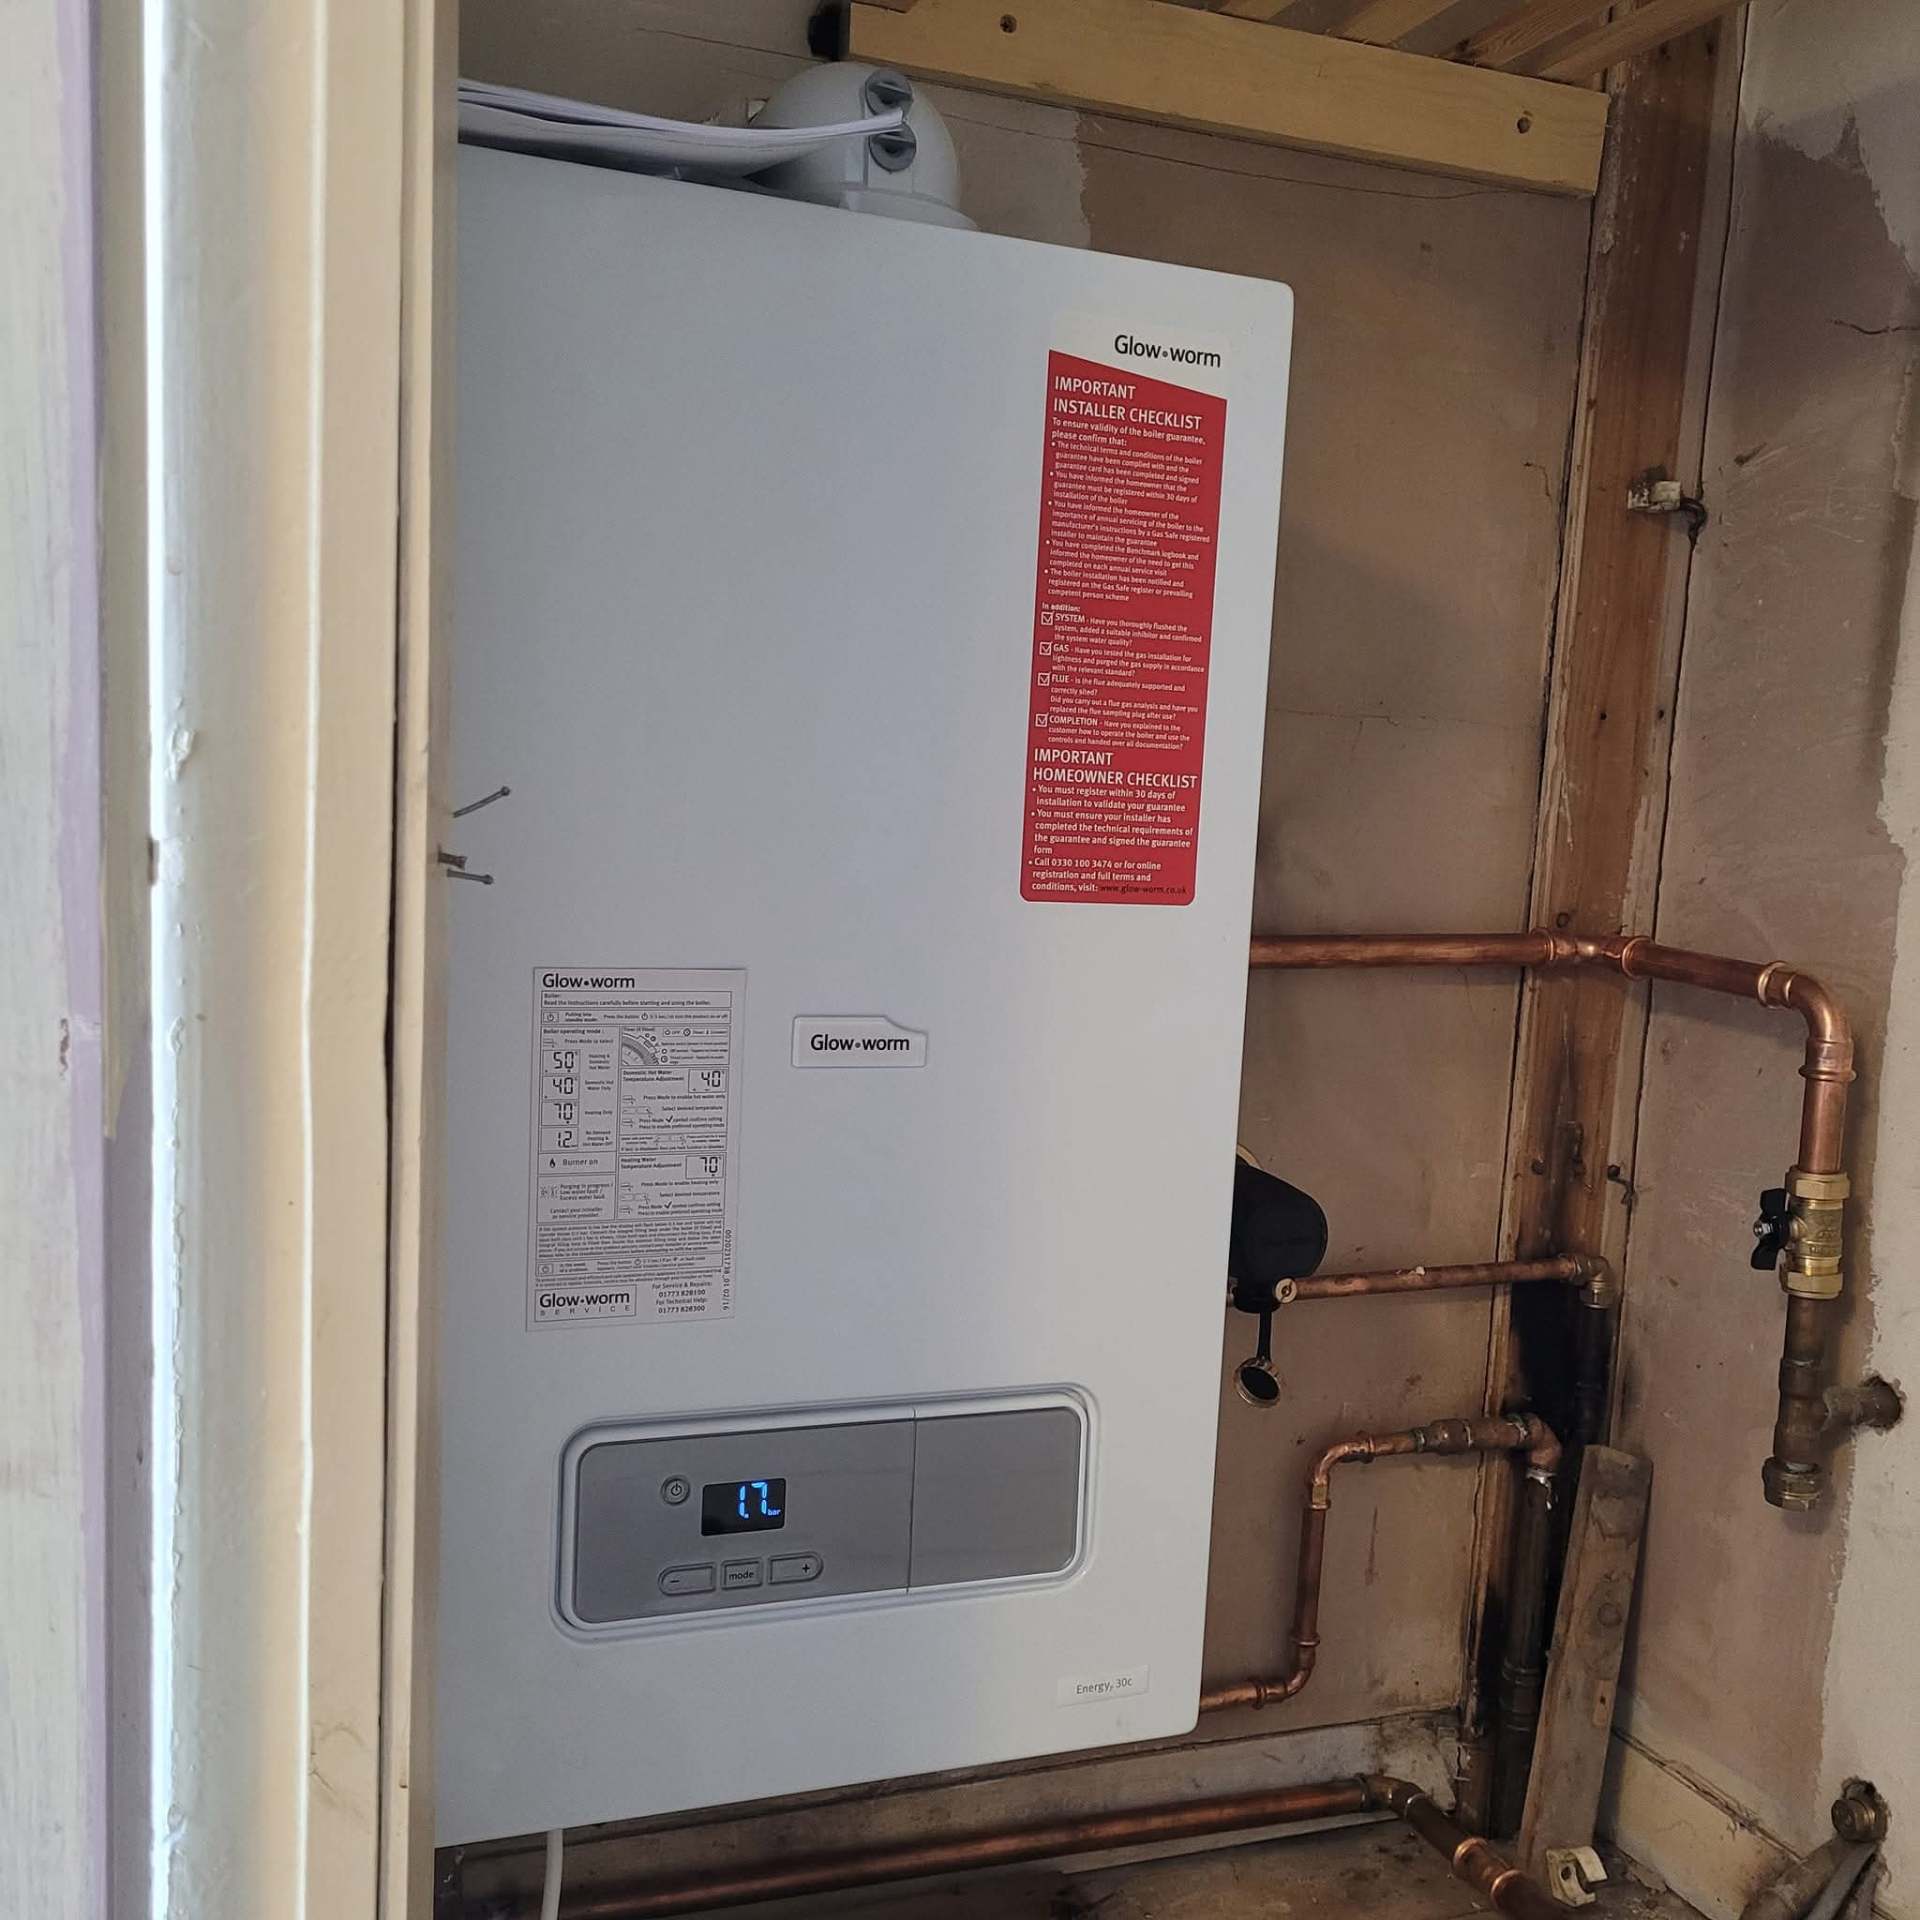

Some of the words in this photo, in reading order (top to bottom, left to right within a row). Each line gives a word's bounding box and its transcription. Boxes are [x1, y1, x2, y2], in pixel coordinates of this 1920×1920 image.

[1055, 375, 1136, 400] IMPORTANT
[1054, 397, 1126, 421] INSTALLER
[1129, 407, 1202, 430] CHECKLIST
[1053, 416, 1061, 426] To
[1062, 420, 1089, 430] ensure
[1090, 422, 1118, 434] validity
[1119, 425, 1128, 435] of
[1129, 427, 1142, 437] the
[1143, 429, 1165, 439] boiler
[1051, 430, 1077, 441] please
[1078, 432, 1107, 444] confirm
[1108, 437, 1127, 446] that:
[1047, 588, 1081, 598] competent
[1082, 591, 1104, 600] person
[1105, 594, 1129, 602] scheme
[1041, 602, 1050, 610] In
[1050, 603, 1081, 612] addition:
[1055, 613, 1086, 623] SYSTEM
[1106, 620, 1118, 628] you
[1119, 620, 1153, 631] thoroughly
[1153, 622, 1177, 631] flushed
[1054, 633, 1065, 641] the
[1066, 635, 1088, 644] system
[1053, 643, 1070, 653] GAS
[1135, 652, 1147, 661] gas
[1147, 653, 1182, 662] installation
[1182, 655, 1192, 663] for
[1051, 674, 1069, 683] FLUE
[1093, 678, 1106, 686] flue
[1106, 680, 1141, 689] adequately
[1141, 683, 1173, 692] supported
[1049, 715, 1098, 726] COMPLETION
[1132, 723, 1162, 731] explained
[1034, 748, 1114, 765] IMPORTANT
[1033, 767, 1123, 785] HOMEOWNER
[1127, 772, 1198, 789] CHECKLIST
[1038, 785, 1053, 793] You
[1076, 788, 1107, 798] register
[1109, 788, 1134, 797] within
[1135, 789, 1146, 799] 30
[1147, 791, 1166, 800] days
[1167, 791, 1176, 800] of
[1036, 797, 1082, 807] installation
[1084, 800, 1092, 808] to
[1094, 800, 1126, 809] validate
[1127, 803, 1145, 812] your
[1146, 804, 1186, 813] guarantee
[1037, 809, 1052, 818] You
[1053, 811, 1074, 819] must
[1075, 812, 1103, 820] ensure
[1104, 814, 1121, 822] your
[1123, 813, 1156, 822] installer
[1157, 815, 1171, 823] has
[1035, 822, 1078, 832] completed
[1079, 823, 1093, 832] the
[1094, 824, 1131, 833] technical
[1131, 827, 1183, 836] requirements
[1185, 827, 1193, 836] of
[1034, 833, 1048, 842] the
[1049, 835, 1090, 845] guarantee
[1109, 838, 1136, 847] signed
[1136, 838, 1150, 846] the
[1151, 840, 1191, 849] guarantee
[1033, 846, 1053, 854] form
[1034, 857, 1050, 866] Call
[1051, 858, 1073, 867] 0330
[1075, 859, 1090, 868] 100
[1092, 860, 1112, 868] 3474
[1124, 860, 1135, 869] for
[1136, 862, 1161, 870] online
[1032, 871, 1079, 880] registration
[1081, 872, 1096, 880] and
[1097, 871, 1111, 880] full
[1136, 874, 1151, 882] and
[1031, 883, 1077, 891] conditions,
[1078, 883, 1099, 892] visit:
[562, 1158, 587, 1166] Burner
[658, 1290, 679, 1298] 01773
[729, 1570, 754, 1580] mode
[1115, 1677, 1133, 1688] 30c
